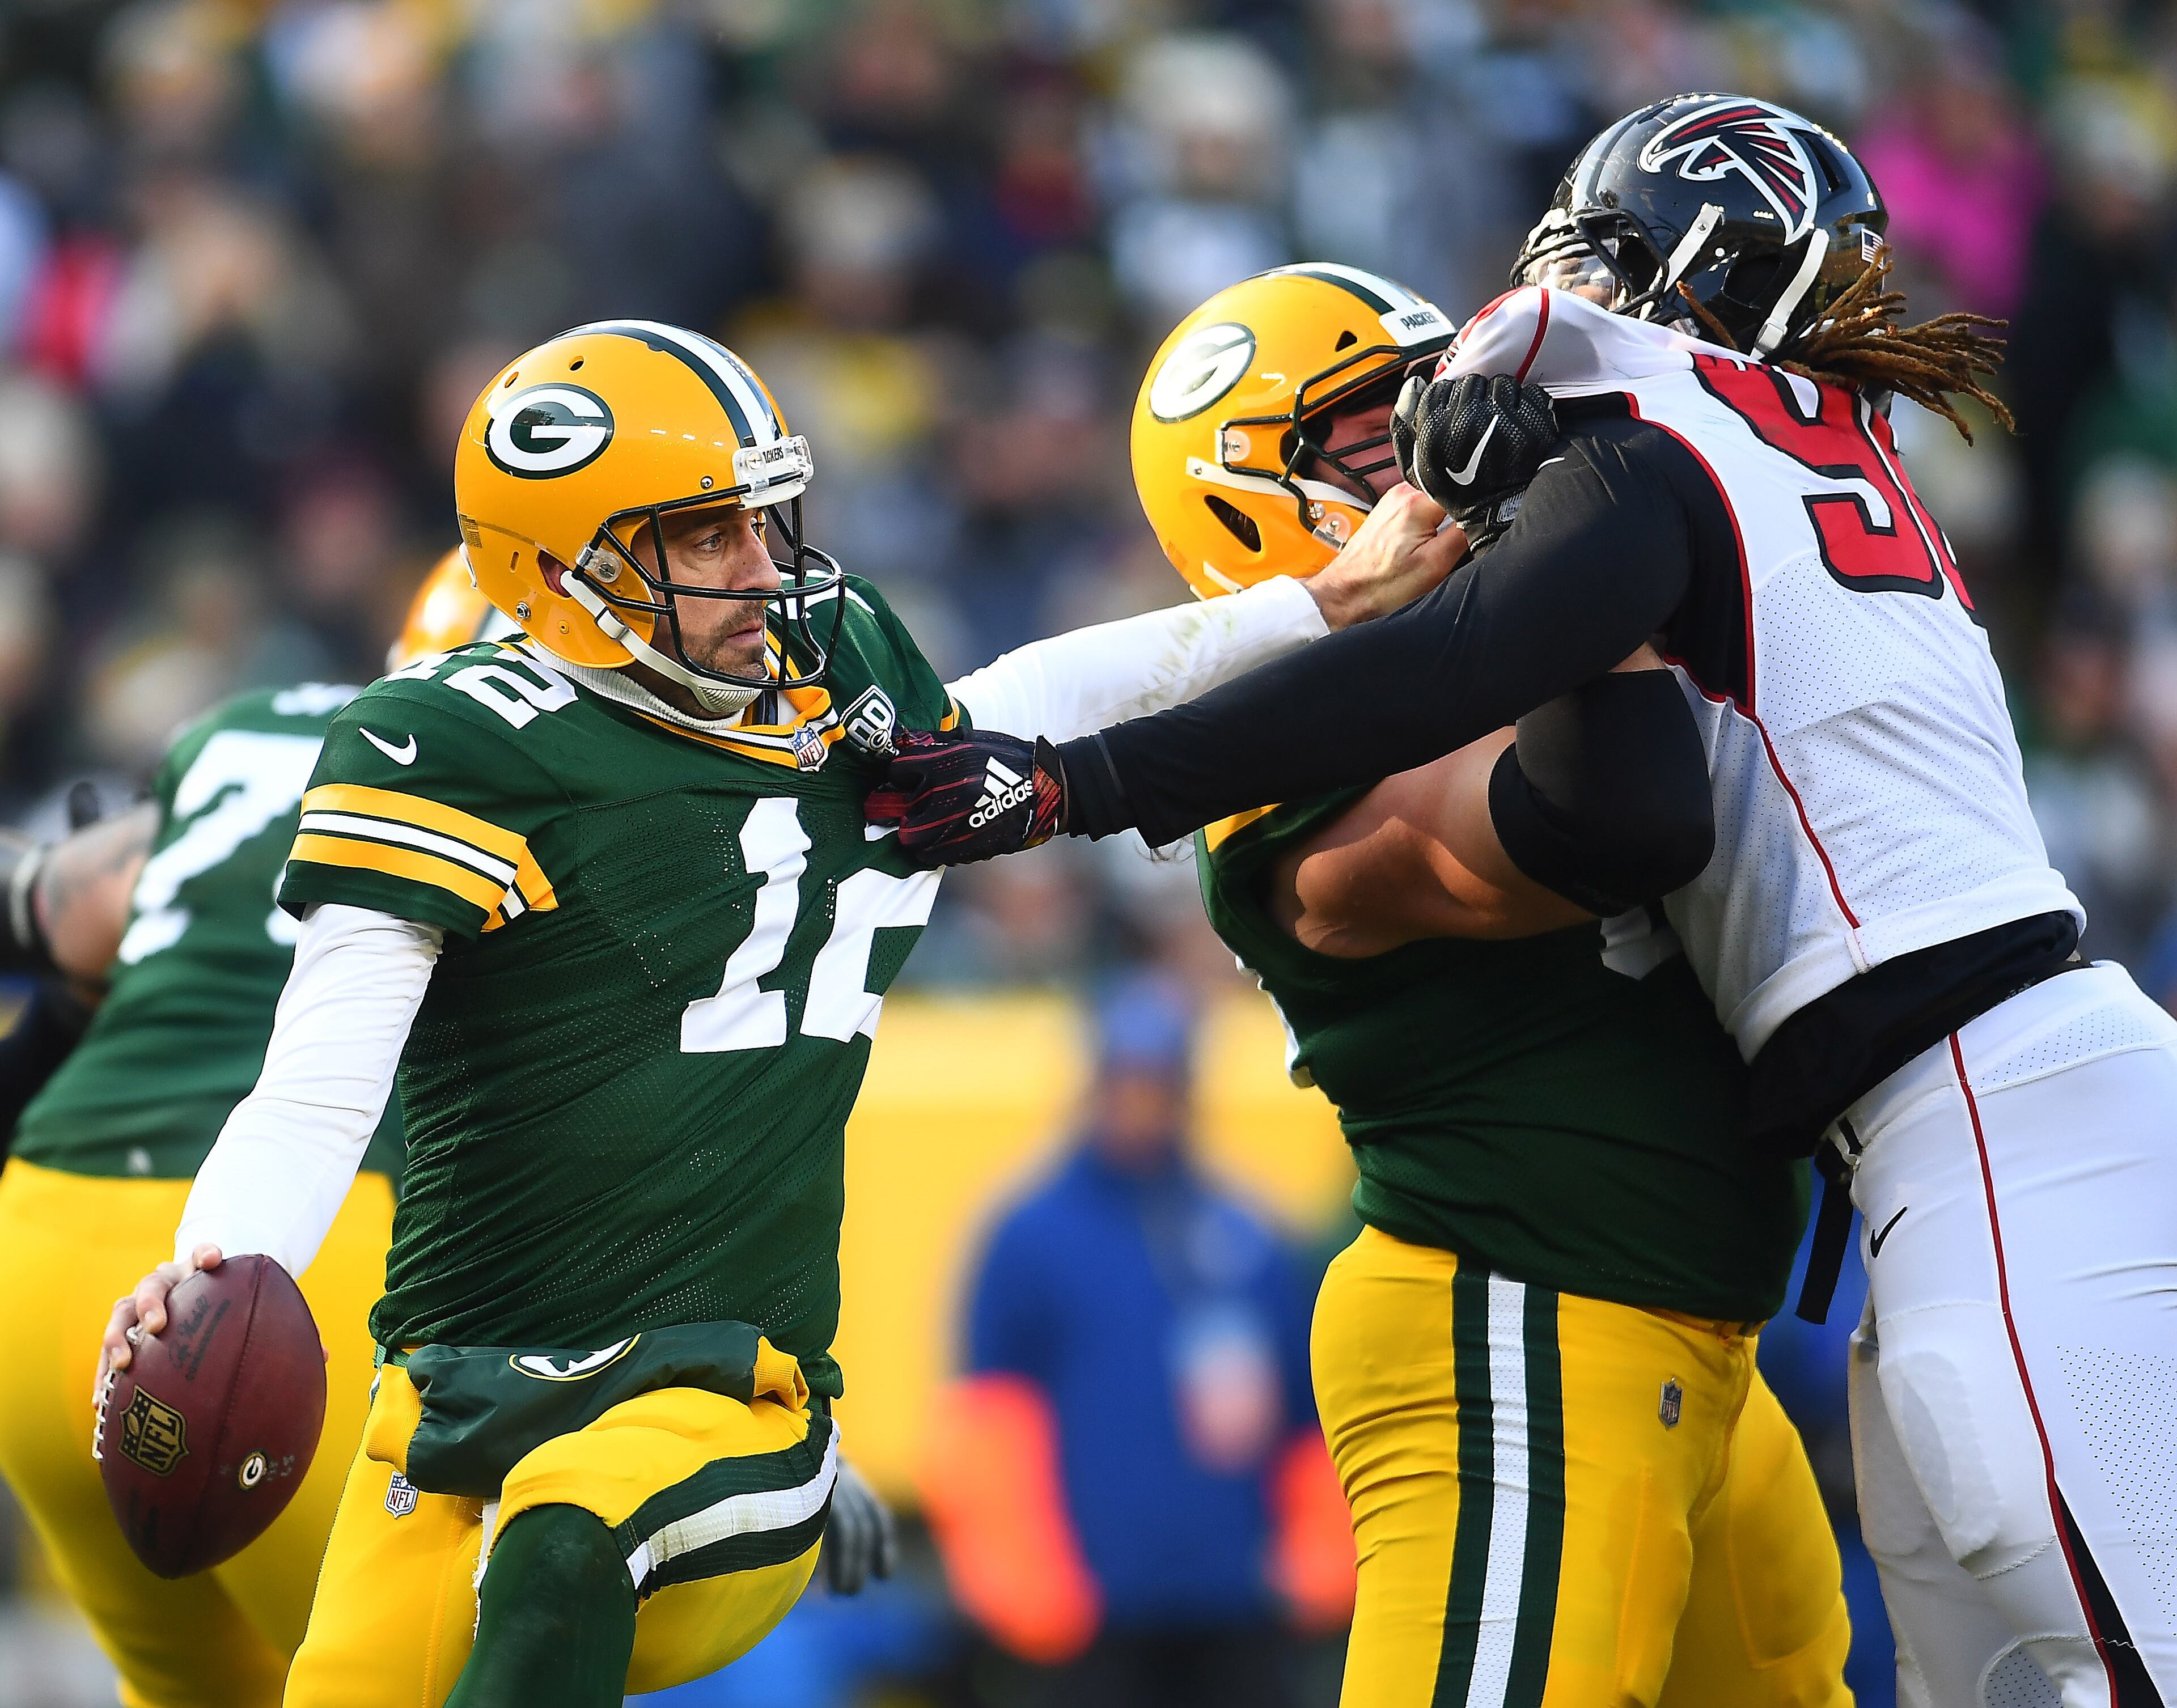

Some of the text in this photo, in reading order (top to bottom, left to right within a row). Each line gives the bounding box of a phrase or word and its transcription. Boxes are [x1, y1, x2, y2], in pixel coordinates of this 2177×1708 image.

[489, 387, 612, 472] G
[800, 741, 824, 765] NFL
[969, 779, 1033, 828] adidas
[139, 1414, 176, 1469] NFL
[242, 1456, 263, 1486] G
[388, 1489, 410, 1510] NFL
